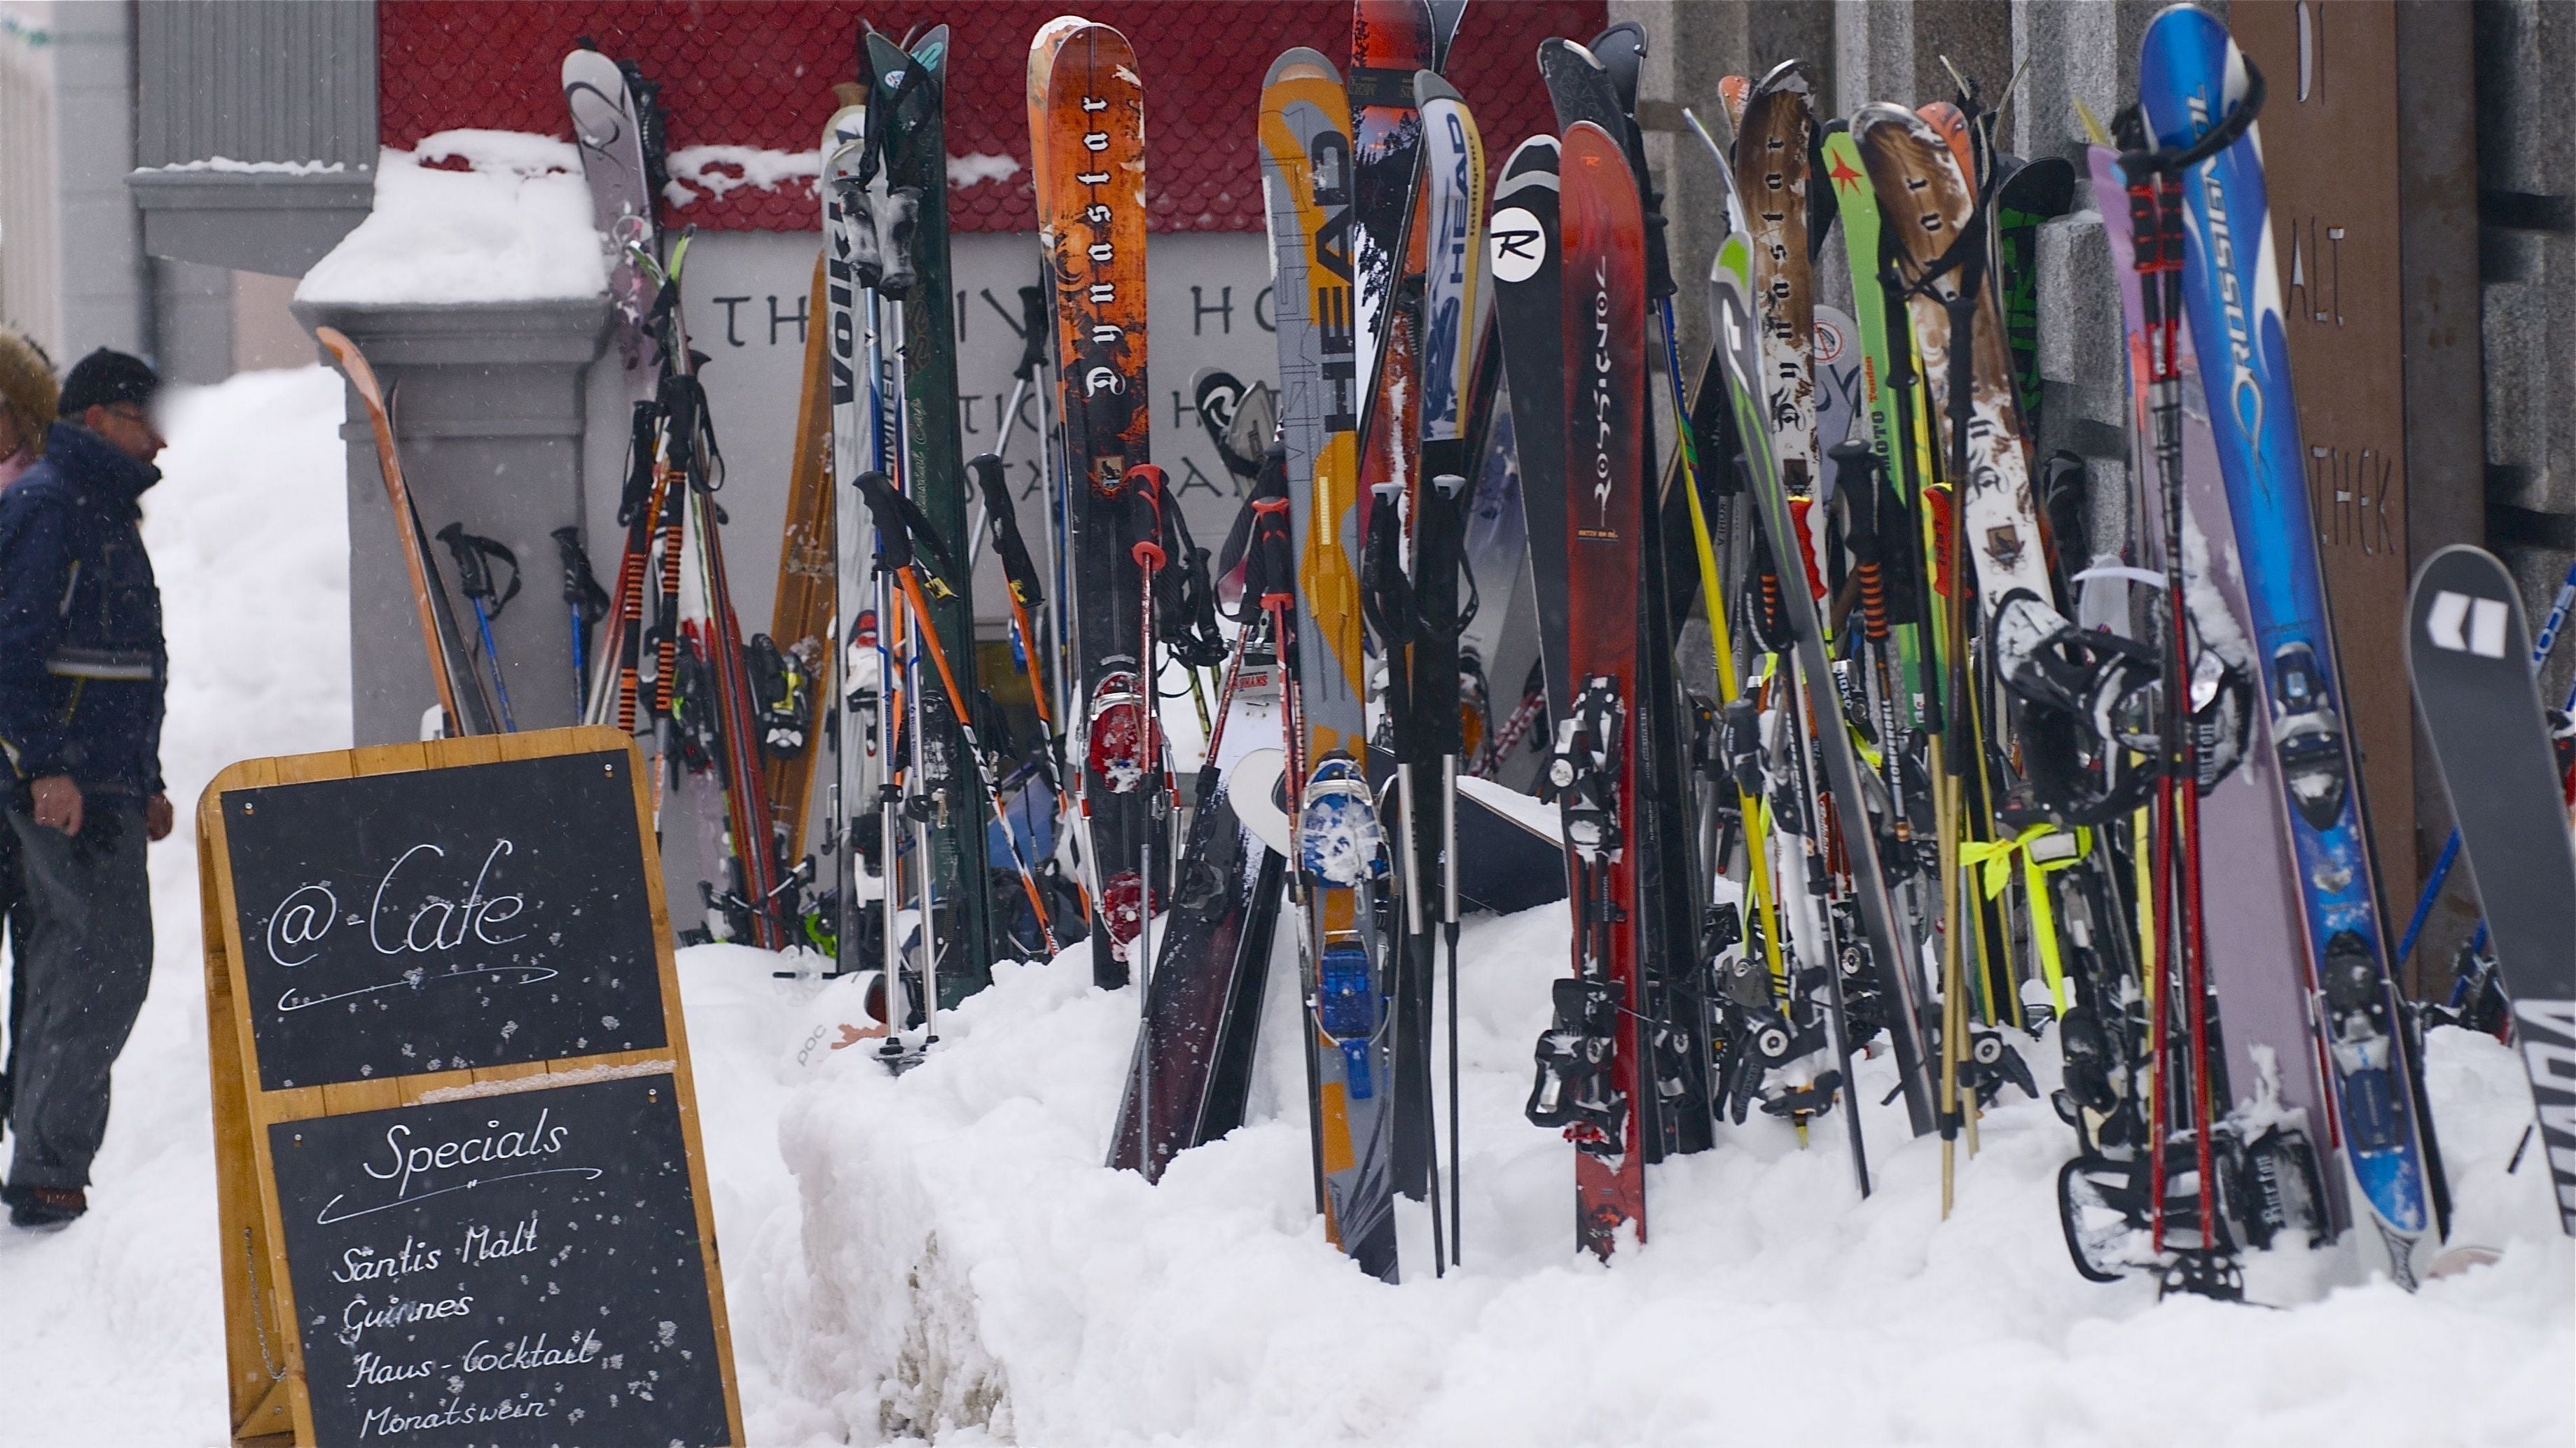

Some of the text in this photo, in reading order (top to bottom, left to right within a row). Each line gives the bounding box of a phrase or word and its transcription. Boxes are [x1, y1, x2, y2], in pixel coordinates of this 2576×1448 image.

[1076, 97, 1126, 398] Dynastar
[1446, 113, 1471, 284] HEAD
[1491, 230, 1539, 259] R
[712, 294, 810, 347] TH
[1311, 130, 1357, 433] HEAD
[1762, 137, 1805, 432] Dynastar
[2285, 216, 2346, 328] ALT
[1593, 255, 1612, 527] ROSSIGNOL
[2311, 445, 2397, 557] THEK
[363, 1108, 568, 1198] Specials
[462, 1218, 538, 1262] Malt
[359, 1393, 549, 1440] Monatswein
